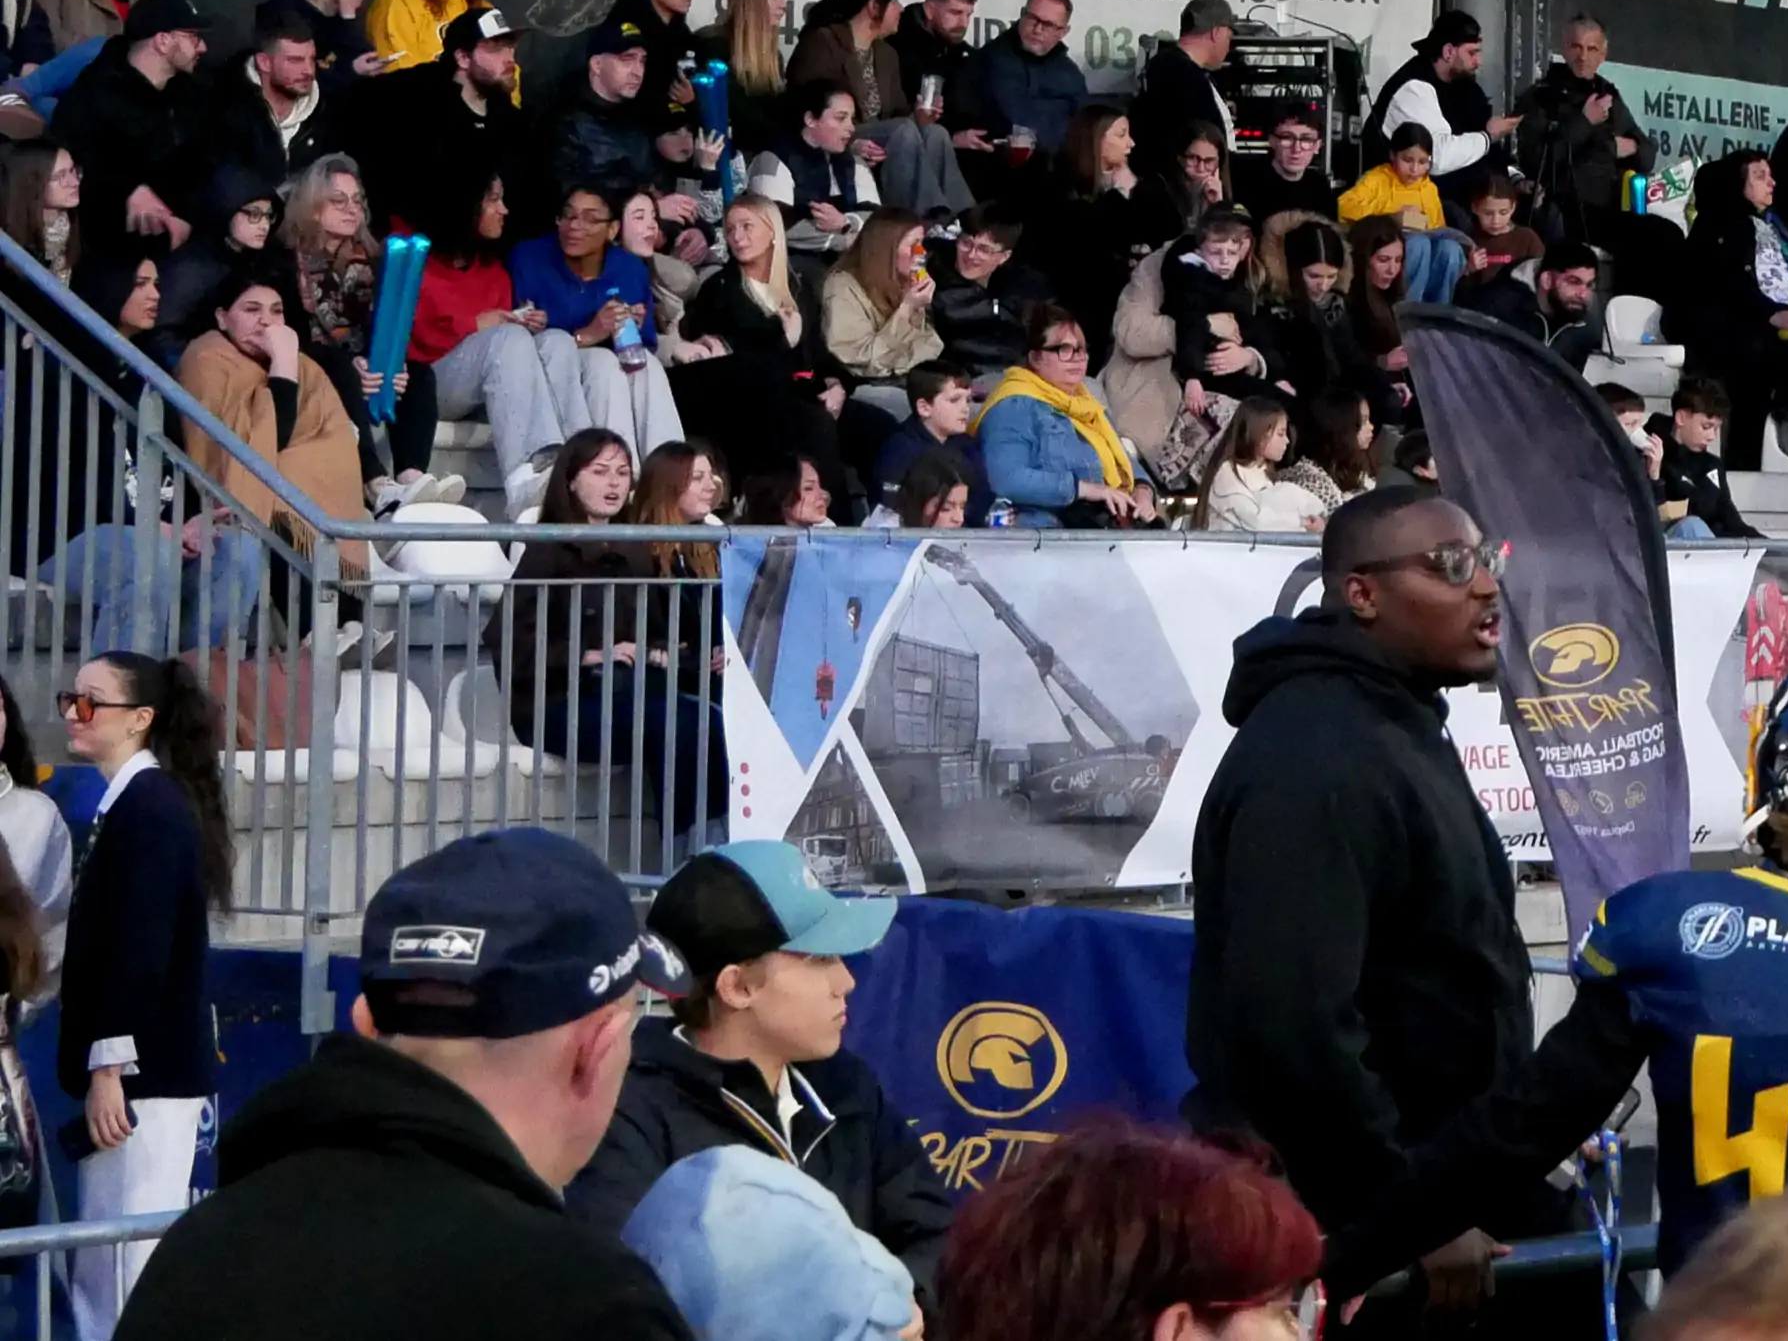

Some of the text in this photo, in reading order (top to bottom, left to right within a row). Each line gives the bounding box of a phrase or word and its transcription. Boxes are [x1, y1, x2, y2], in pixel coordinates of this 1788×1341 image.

[1644, 84, 1770, 131] MÉTALLERIE
[1478, 787, 1537, 813] STOC
[1501, 831, 1548, 848] cont
